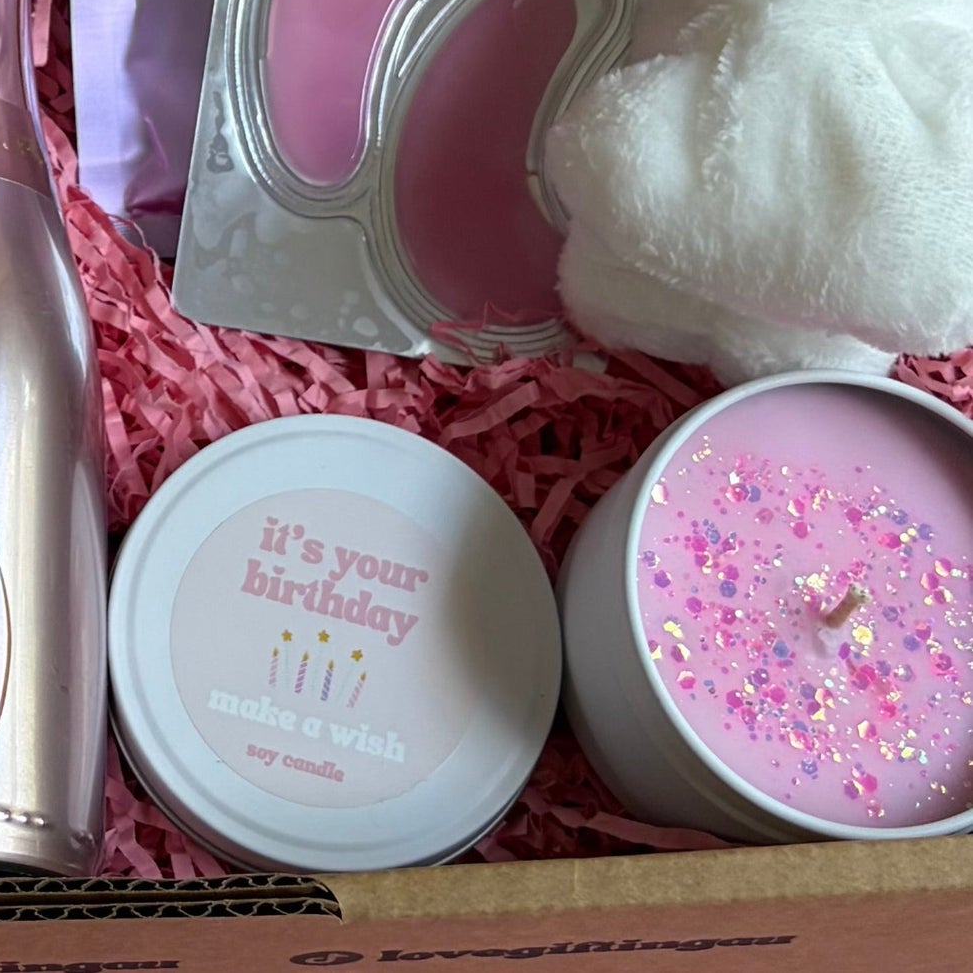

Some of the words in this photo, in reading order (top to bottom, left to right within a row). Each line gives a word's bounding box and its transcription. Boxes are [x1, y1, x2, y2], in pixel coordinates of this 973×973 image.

[259, 516, 325, 565] it's
[329, 546, 429, 593] your
[240, 558, 419, 646] birthday
[207, 688, 297, 732] make
[302, 718, 323, 739] a
[329, 723, 406, 763] wish
[246, 743, 279, 767] soy
[282, 752, 345, 783] candle
[377, 935, 798, 962] lovegiftingau
